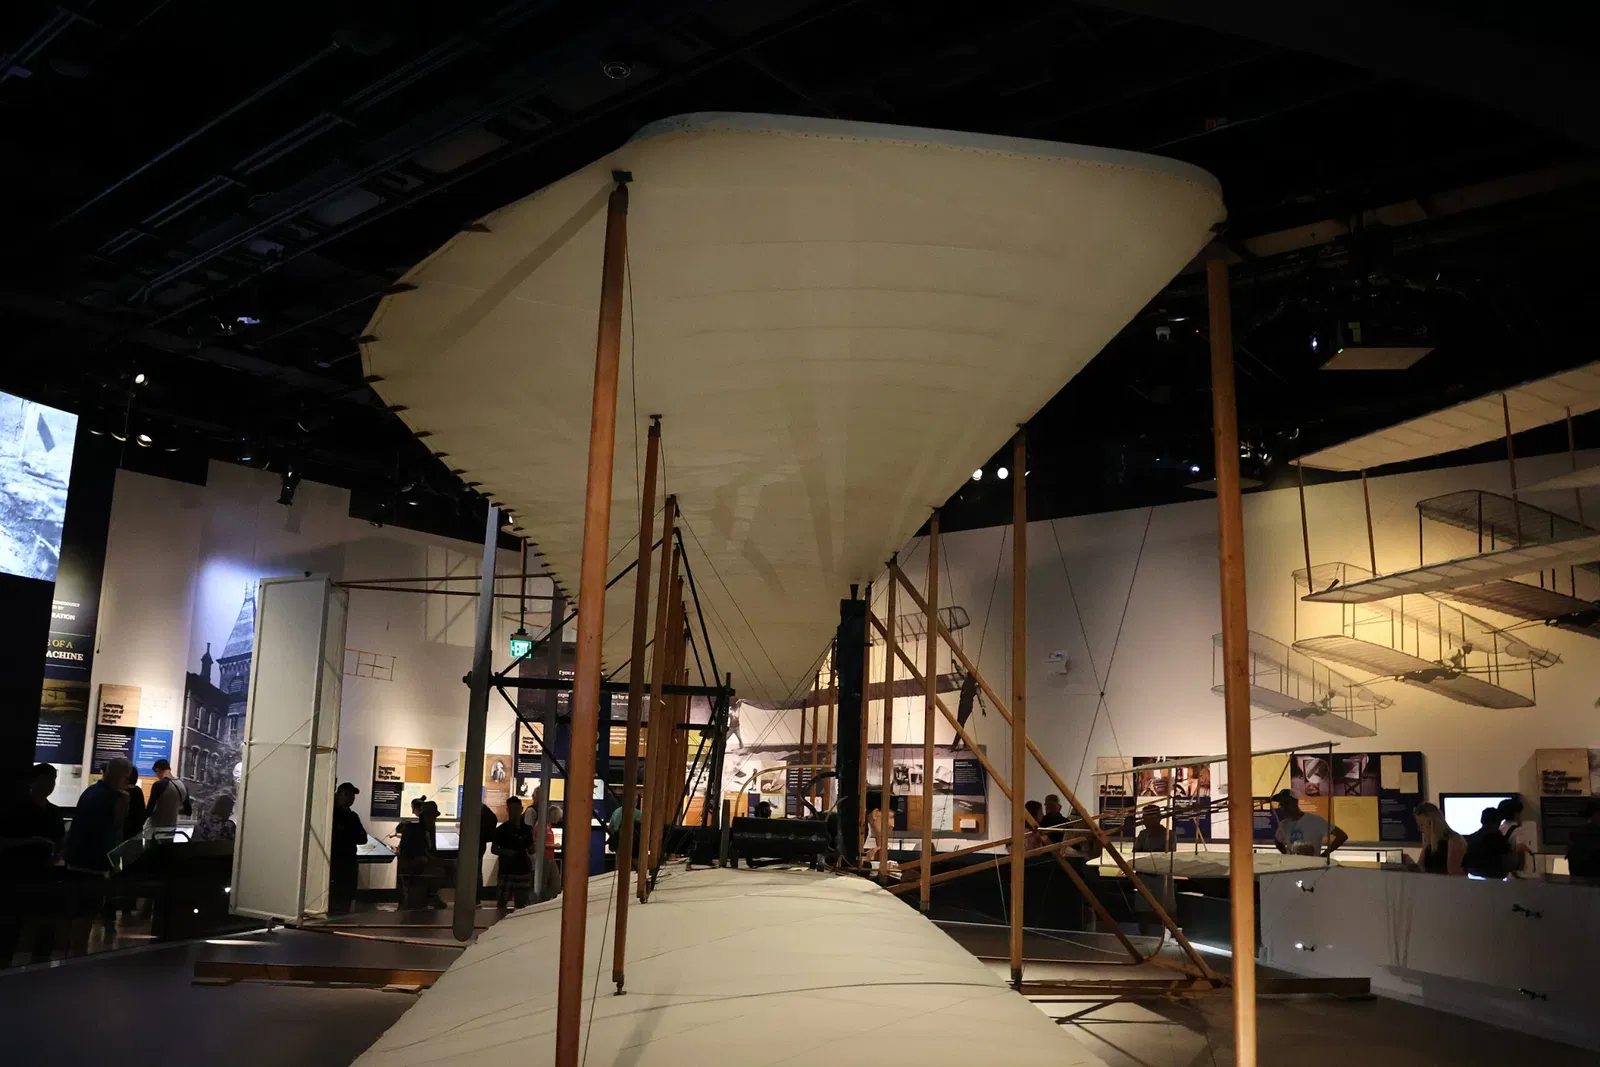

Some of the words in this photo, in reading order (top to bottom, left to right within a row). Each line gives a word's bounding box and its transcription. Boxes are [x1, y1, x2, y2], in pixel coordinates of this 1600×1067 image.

[52, 639, 65, 648] OF
[66, 641, 73, 649] A
[46, 650, 84, 661] ACHINE
